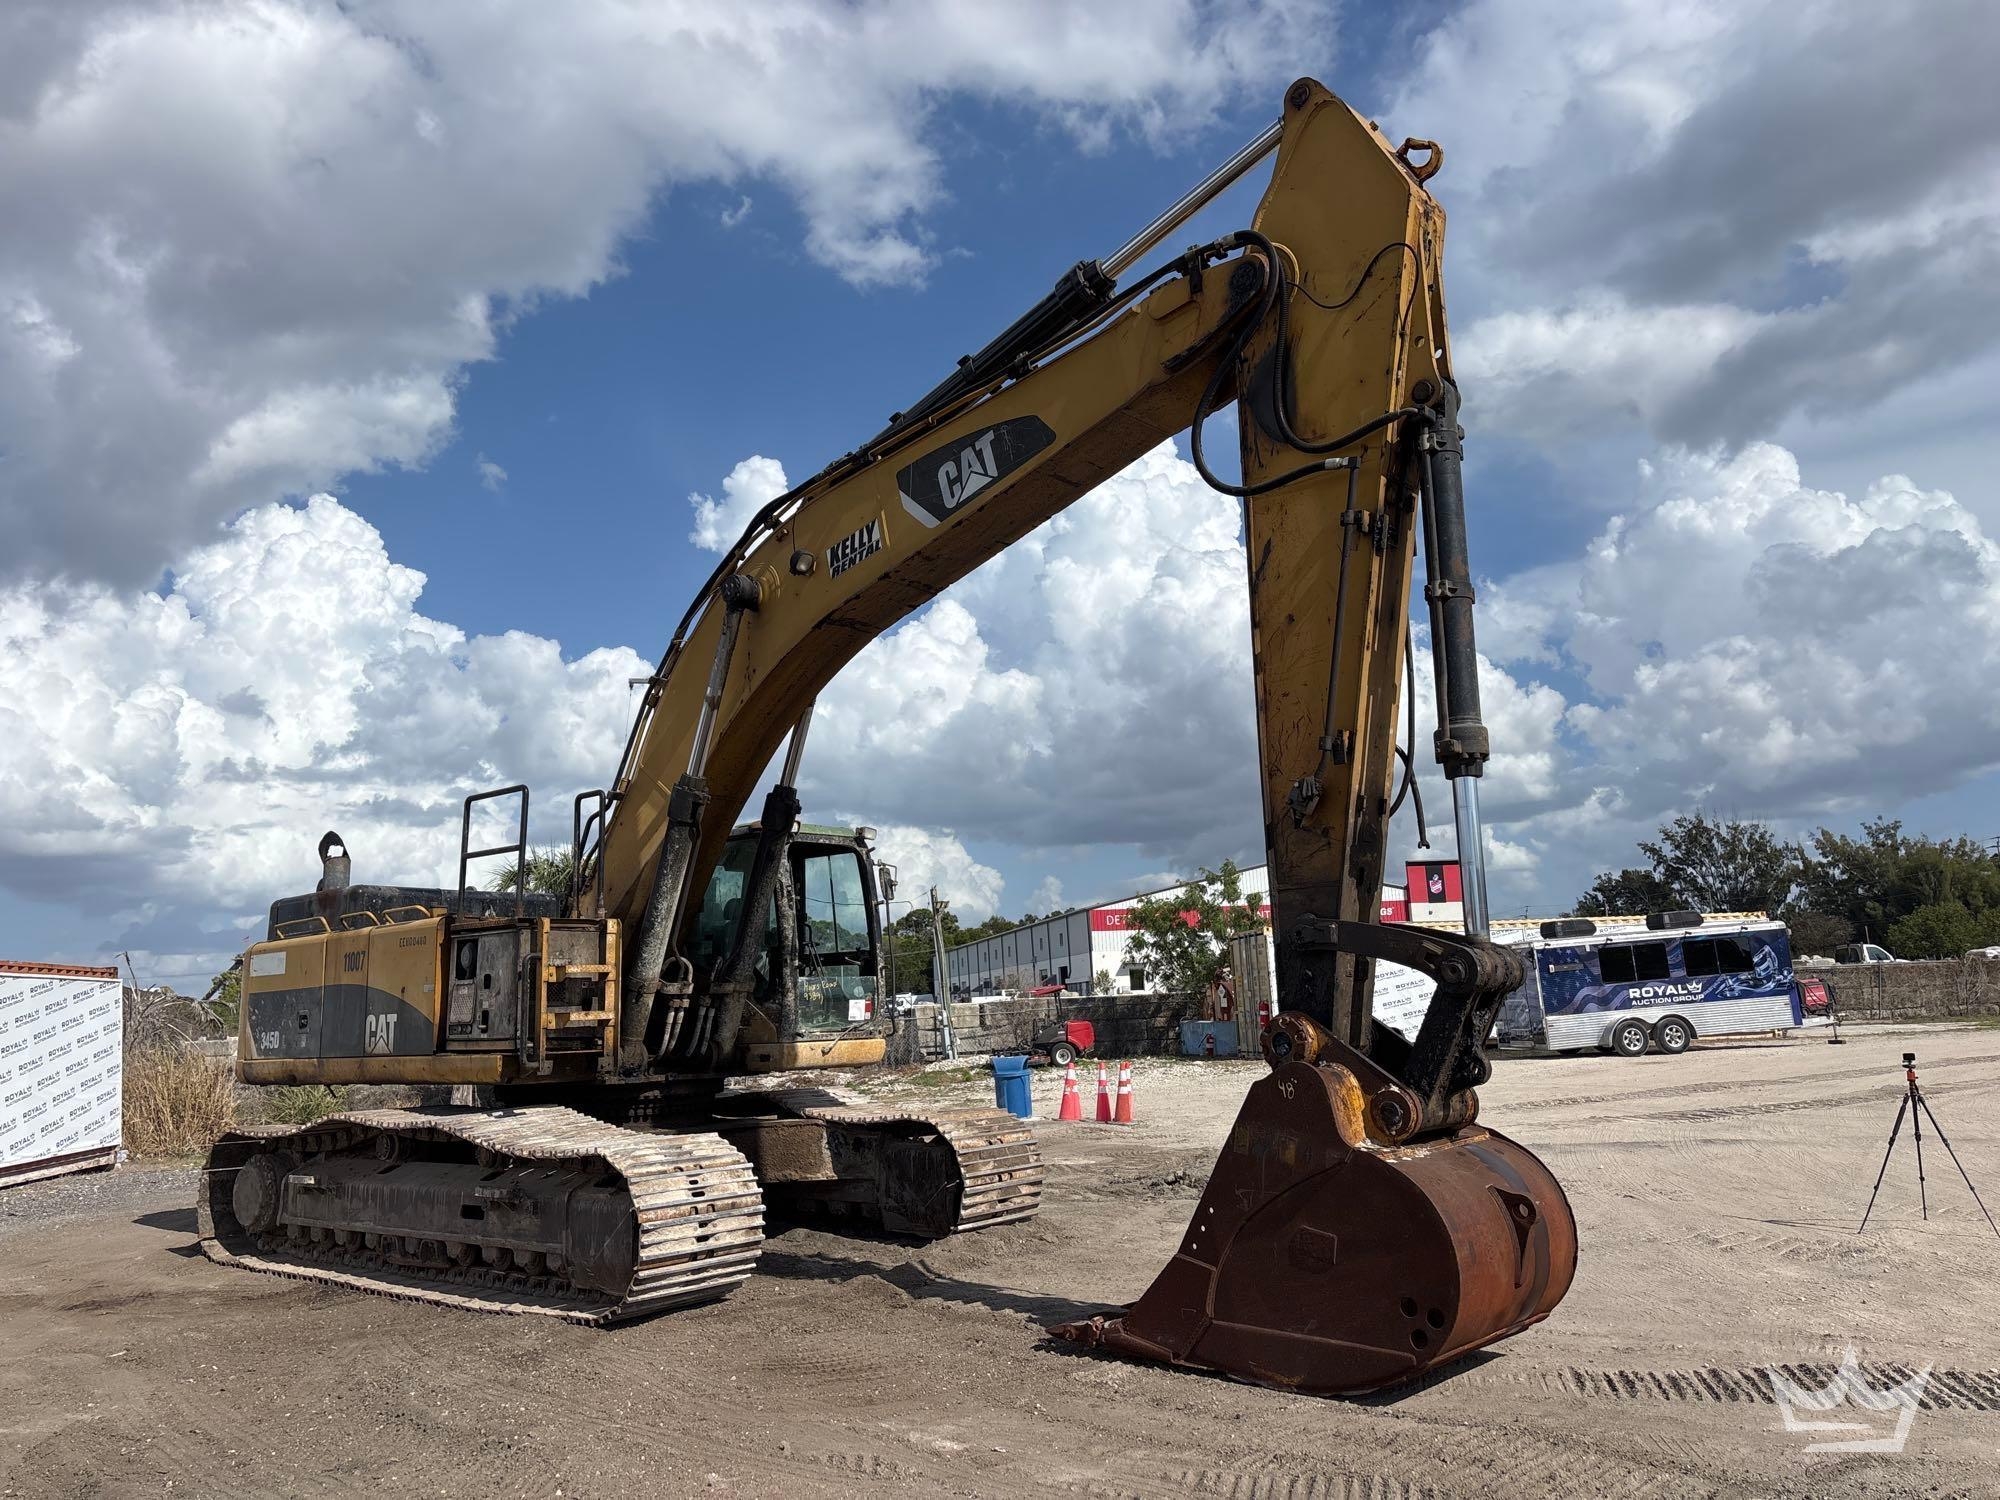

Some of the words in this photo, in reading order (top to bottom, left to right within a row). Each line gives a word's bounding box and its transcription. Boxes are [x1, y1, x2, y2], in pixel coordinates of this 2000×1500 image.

[937, 429, 999, 509] CAT
[830, 517, 877, 568] KELLY
[832, 539, 882, 579] RENTAL
[344, 951, 366, 972] 11007
[30, 983, 48, 993] ROYAL
[1396, 980, 1418, 989] ROYAL
[73, 989, 89, 999] ROYAL
[1629, 984, 1688, 998] ROYAL
[45, 1000, 63, 1010] ROYAL
[1383, 999, 1405, 1007] ROYAL
[1631, 998, 1671, 1006] AUCTION
[1673, 994, 1705, 1002] GROUP
[89, 1005, 105, 1015] ROYAL
[1403, 1009, 1426, 1017] ROYAL
[15, 1012, 34, 1023] ROYAL
[62, 1016, 79, 1027] ROYAL
[34, 1028, 52, 1040] ROYAL
[77, 1033, 93, 1044] ROYAL
[365, 1013, 398, 1054] CAT
[260, 1031, 280, 1049] 345D
[1, 1042, 21, 1054] ROYAL
[49, 1045, 66, 1056] ROYAL
[19, 1058, 38, 1071] ROYAL
[66, 1061, 83, 1072] ROYAL
[38, 1074, 56, 1086] ROYAL
[5, 1089, 25, 1102] ROYAL
[53, 1090, 70, 1102] ROYAL
[23, 1106, 42, 1119] ROYAL
[41, 1120, 59, 1133] ROYAL
[10, 1137, 29, 1151] ROYAL
